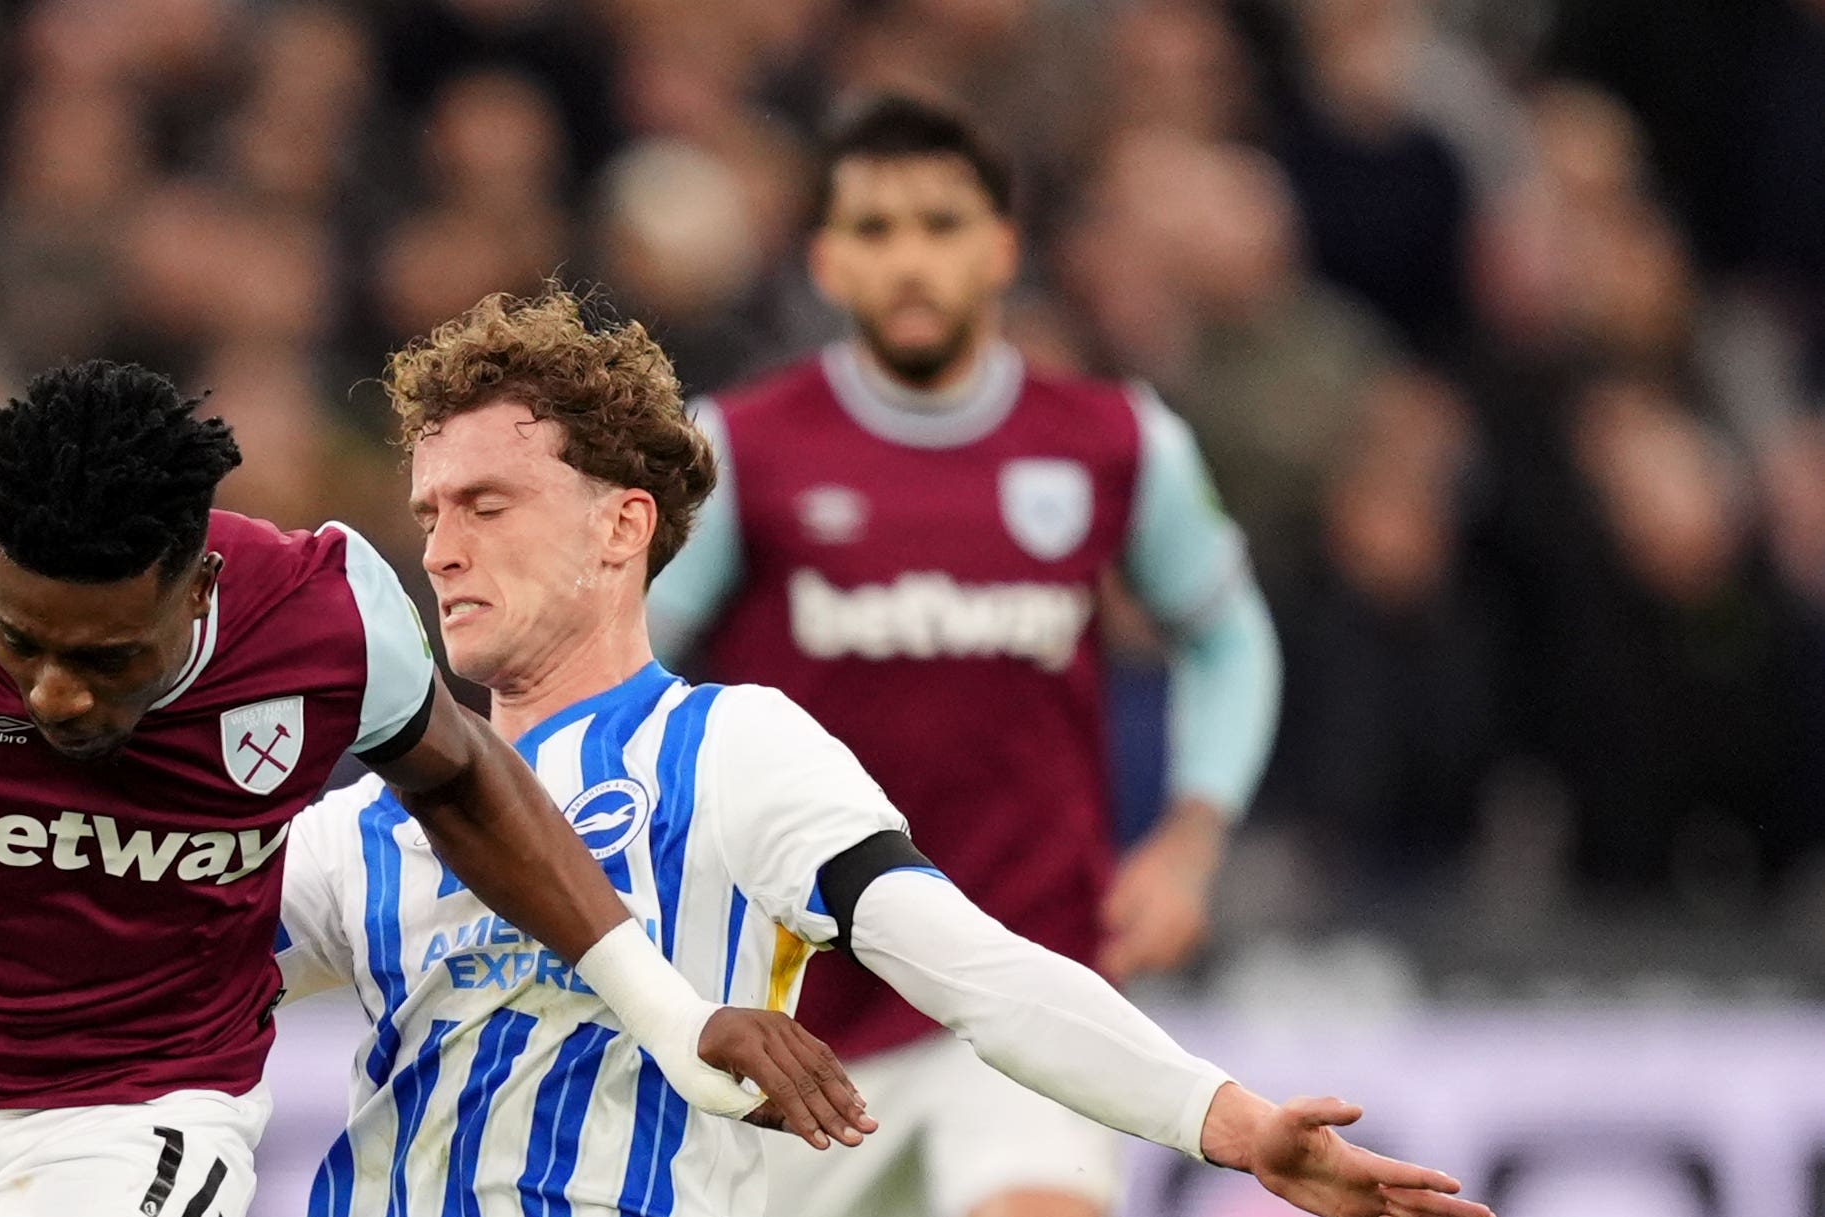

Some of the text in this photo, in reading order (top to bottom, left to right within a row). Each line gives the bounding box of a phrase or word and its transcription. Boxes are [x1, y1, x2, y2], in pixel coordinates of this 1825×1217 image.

[787, 567, 1091, 672] betway
[230, 701, 294, 725] WEST HAM
[569, 783, 611, 813] BRIGHTON
[595, 846, 617, 857] BION
